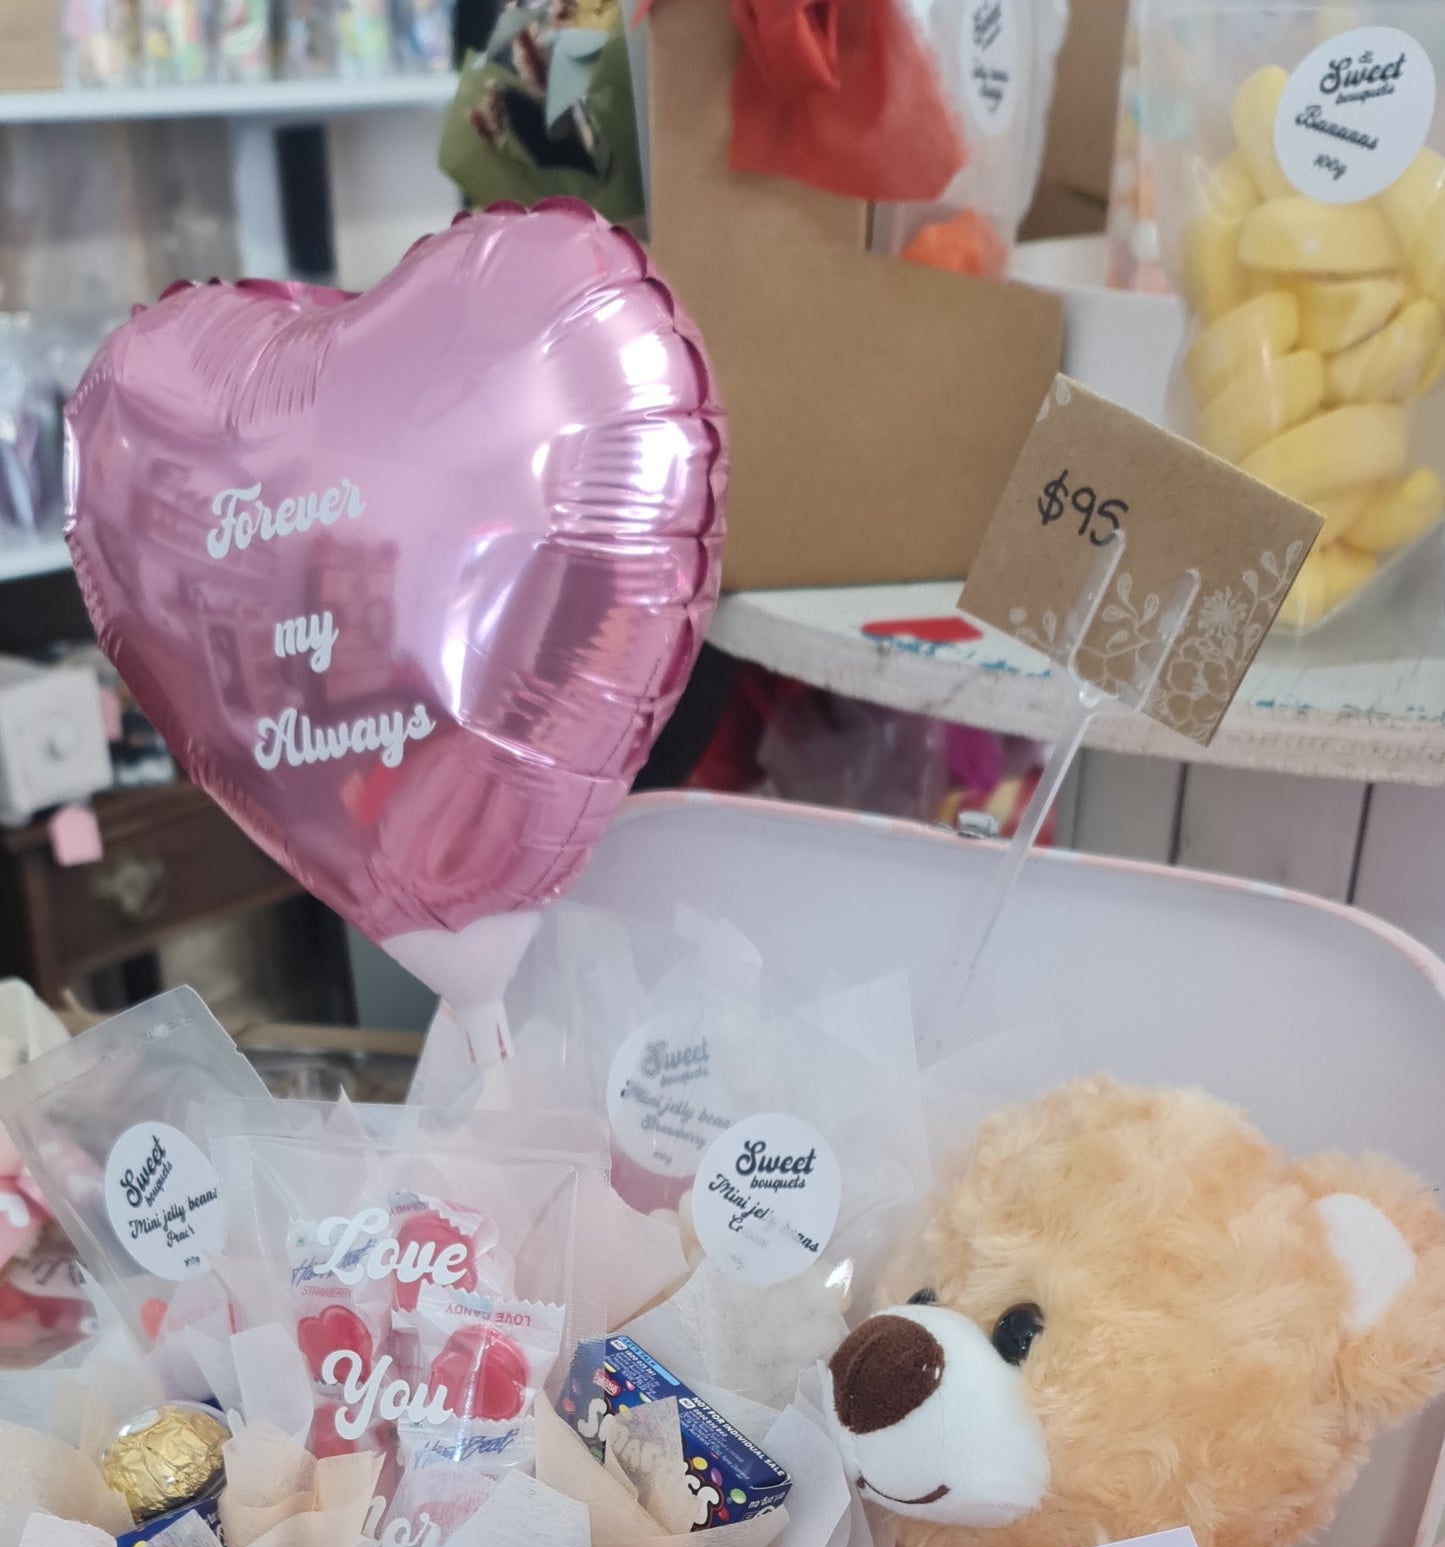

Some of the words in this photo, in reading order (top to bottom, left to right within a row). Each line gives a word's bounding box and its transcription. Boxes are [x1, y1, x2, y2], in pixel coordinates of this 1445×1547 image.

[1319, 53, 1406, 94] Sweet
[1335, 83, 1395, 105] bouquets
[1295, 105, 1378, 150] Bananas
[207, 478, 366, 560] Forever
[1038, 469, 1129, 547] $95
[274, 611, 339, 673] my
[254, 704, 436, 770] Always
[640, 1036, 710, 1079] Sweet
[119, 1135, 167, 1208] Sweet
[735, 1140, 817, 1176] Sweet
[708, 1173, 751, 1209] Mini
[749, 1174, 806, 1193] bouquets
[129, 1214, 162, 1239] Mini
[162, 1202, 187, 1232] jelly
[313, 1207, 468, 1286] Love
[445, 1303, 491, 1321] CANDY
[495, 1311, 532, 1327] LOVE
[322, 1349, 454, 1440] You
[691, 1397, 710, 1411] NOT
[707, 1411, 725, 1424] FOR
[721, 1423, 767, 1459] INDIVIDUAL
[762, 1458, 785, 1476] SALE
